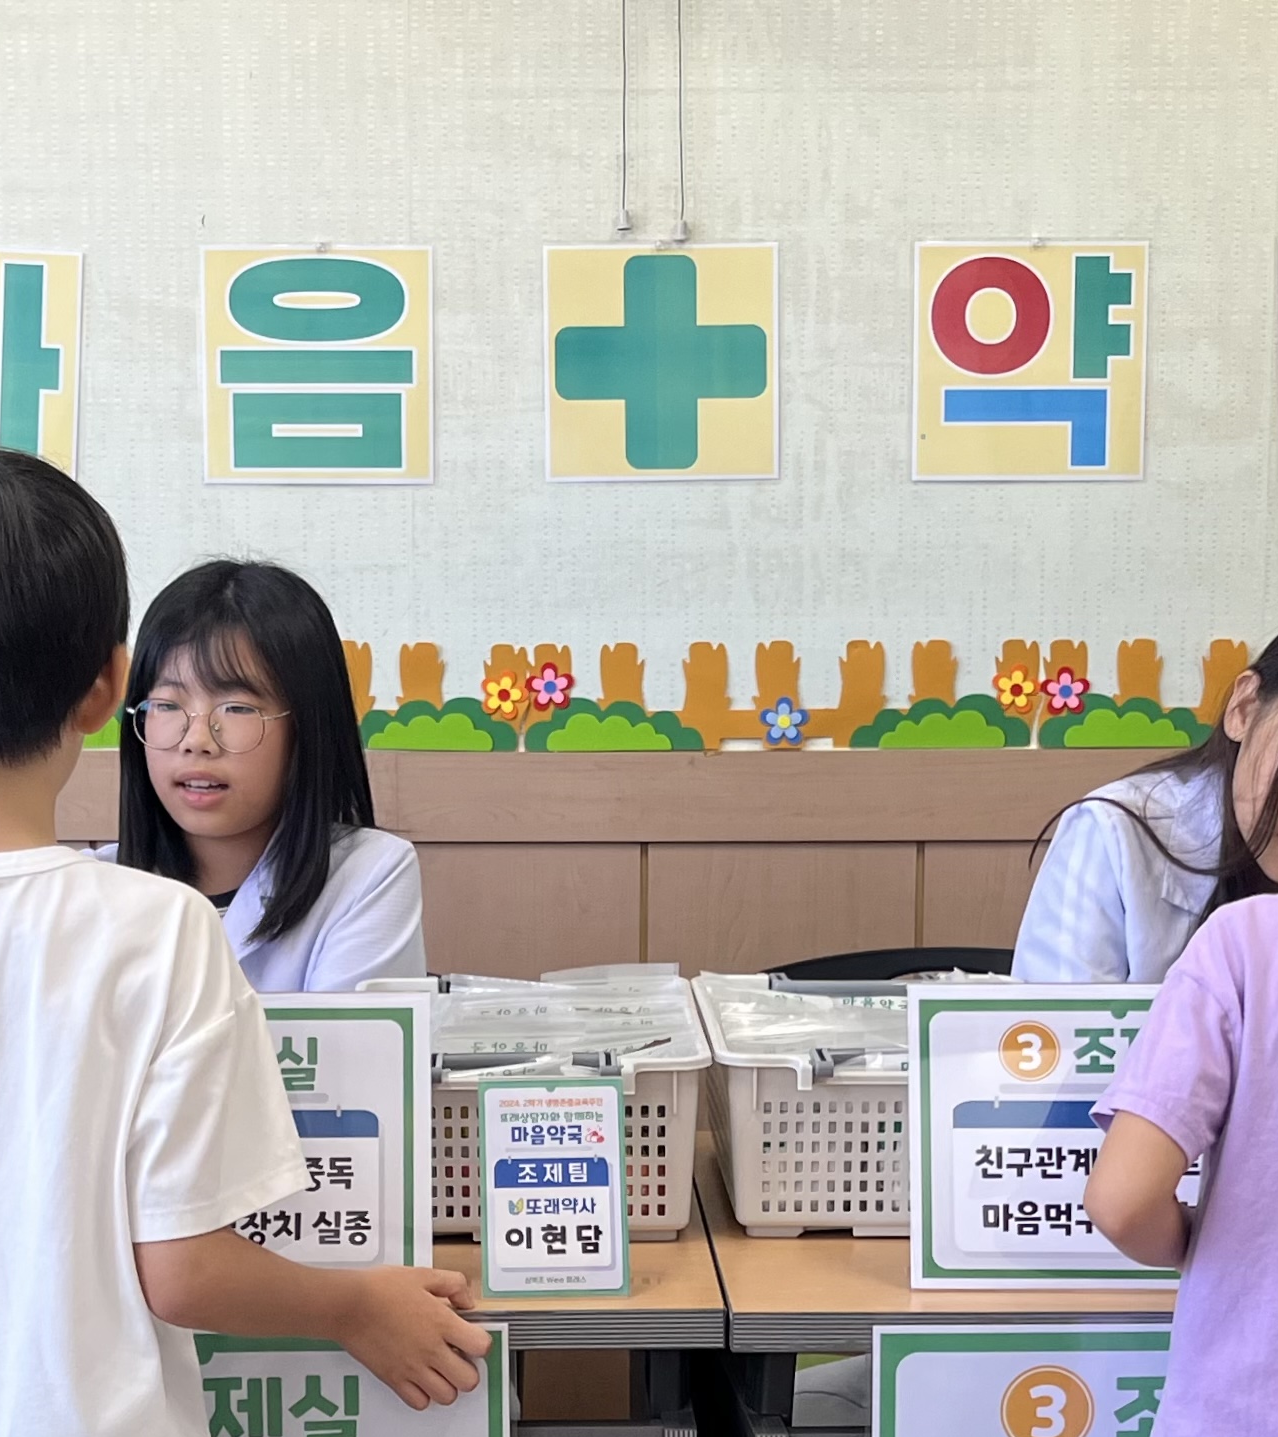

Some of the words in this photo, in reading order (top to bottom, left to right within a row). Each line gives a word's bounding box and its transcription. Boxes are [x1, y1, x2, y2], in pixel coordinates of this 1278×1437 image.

[1016, 1032, 1044, 1072] 3
[511, 1124, 583, 1146] 마음약국
[525, 1196, 597, 1215] 또래약사
[311, 1210, 372, 1246] 실종
